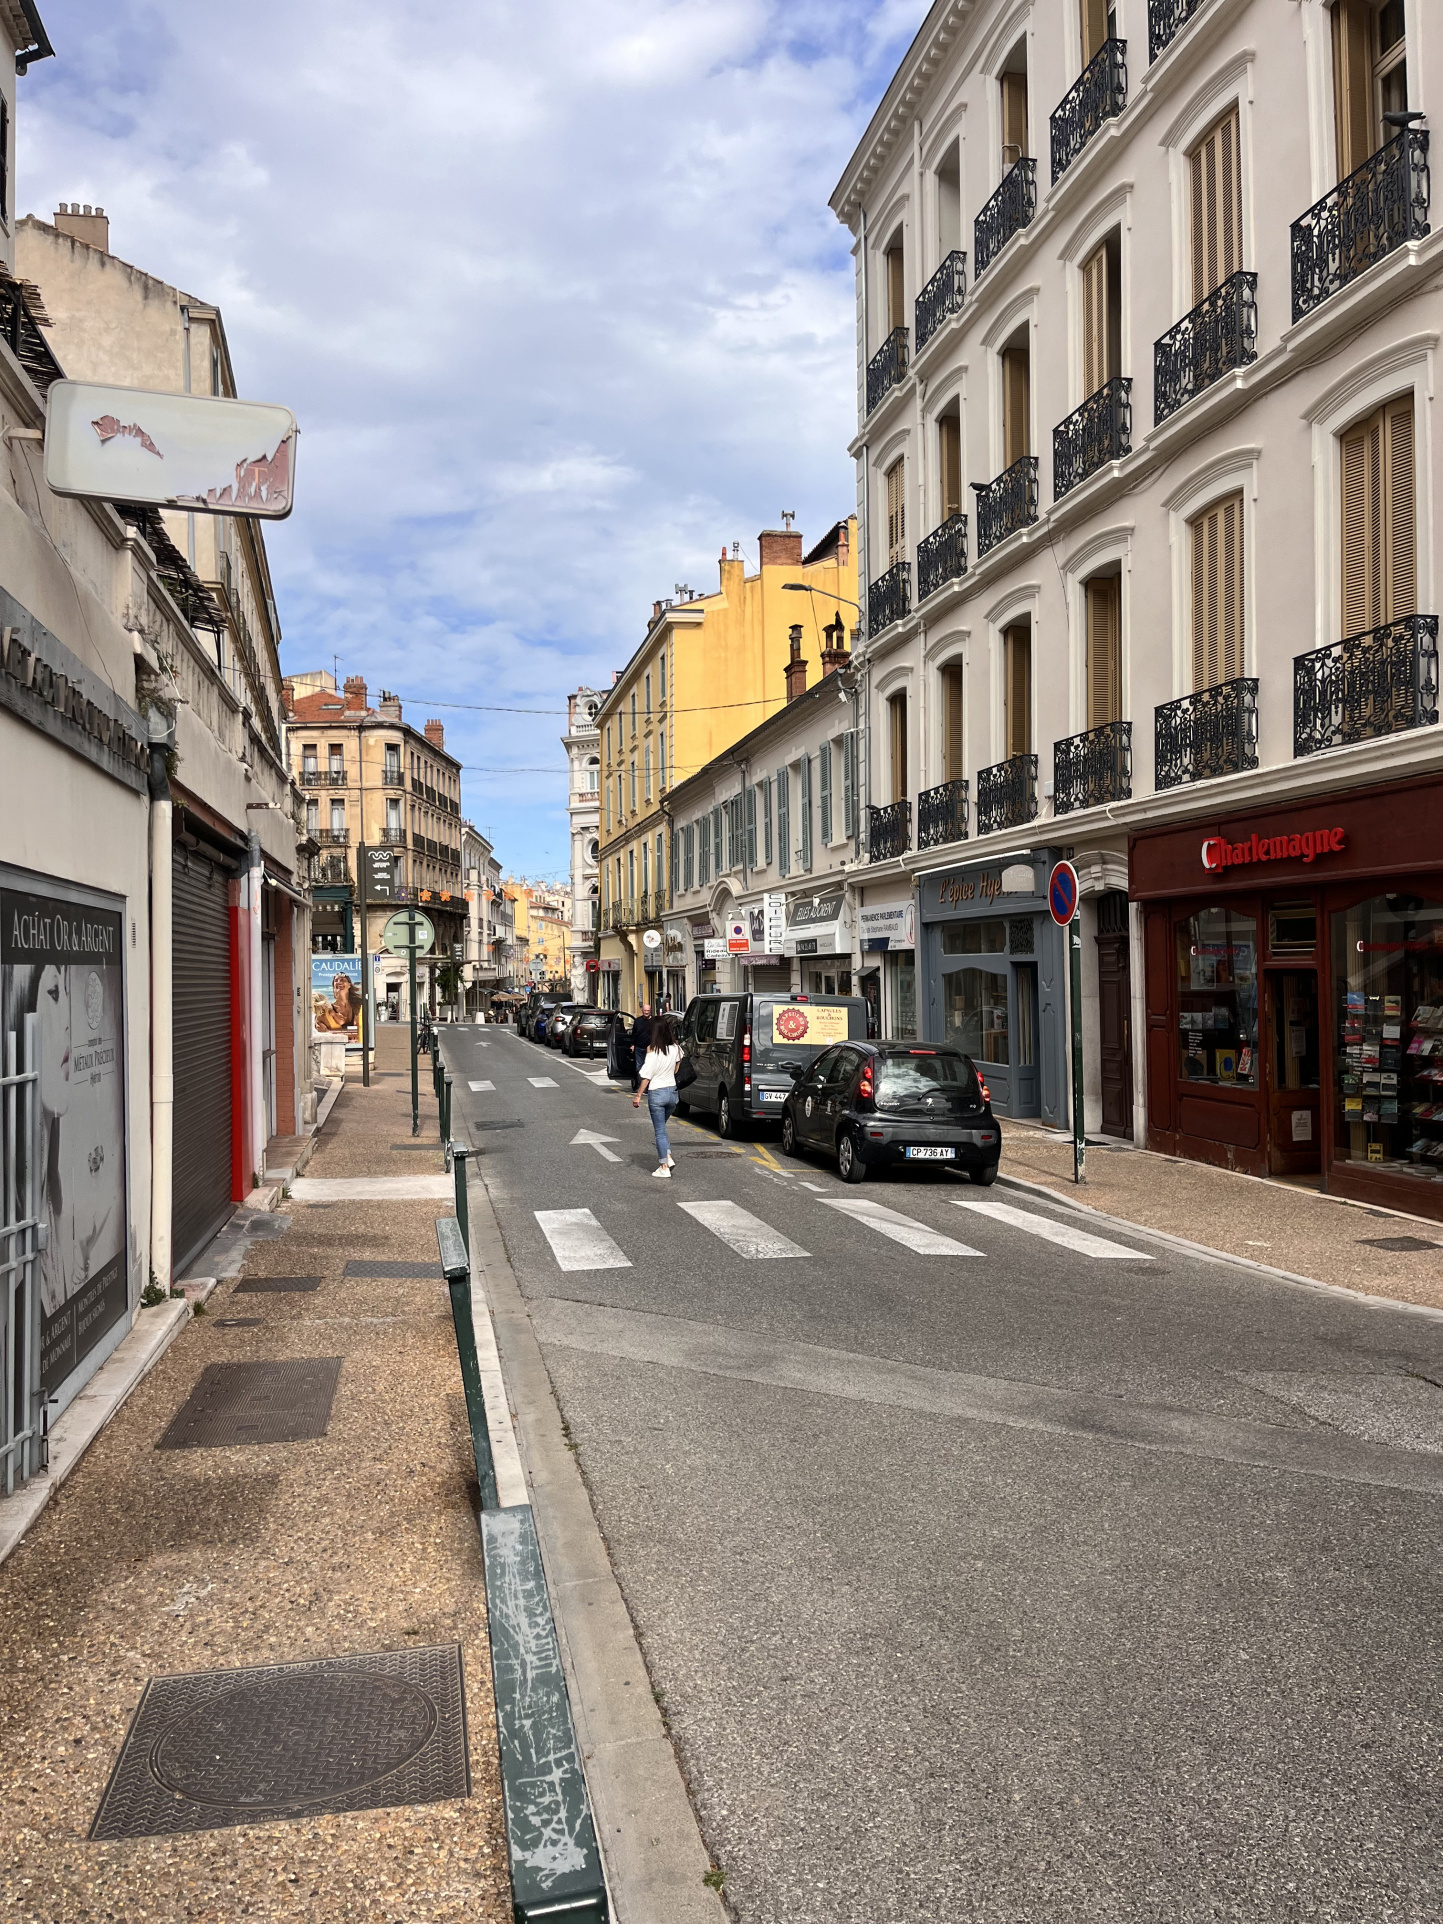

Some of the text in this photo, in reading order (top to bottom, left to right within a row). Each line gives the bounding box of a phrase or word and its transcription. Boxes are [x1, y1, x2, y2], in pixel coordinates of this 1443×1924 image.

[1201, 827, 1346, 870] Charlemagne
[939, 877, 975, 910] L'épice
[796, 901, 837, 921] ELLES ADORENT
[860, 910, 904, 923] PERMANENCE PARLEMENTAIRE
[11, 908, 114, 953] ACHAT OR & ARGENT
[780, 1011, 805, 1025] CAPSULES
[788, 1020, 796, 1029] &
[51, 1310, 71, 1342] ARGENT
